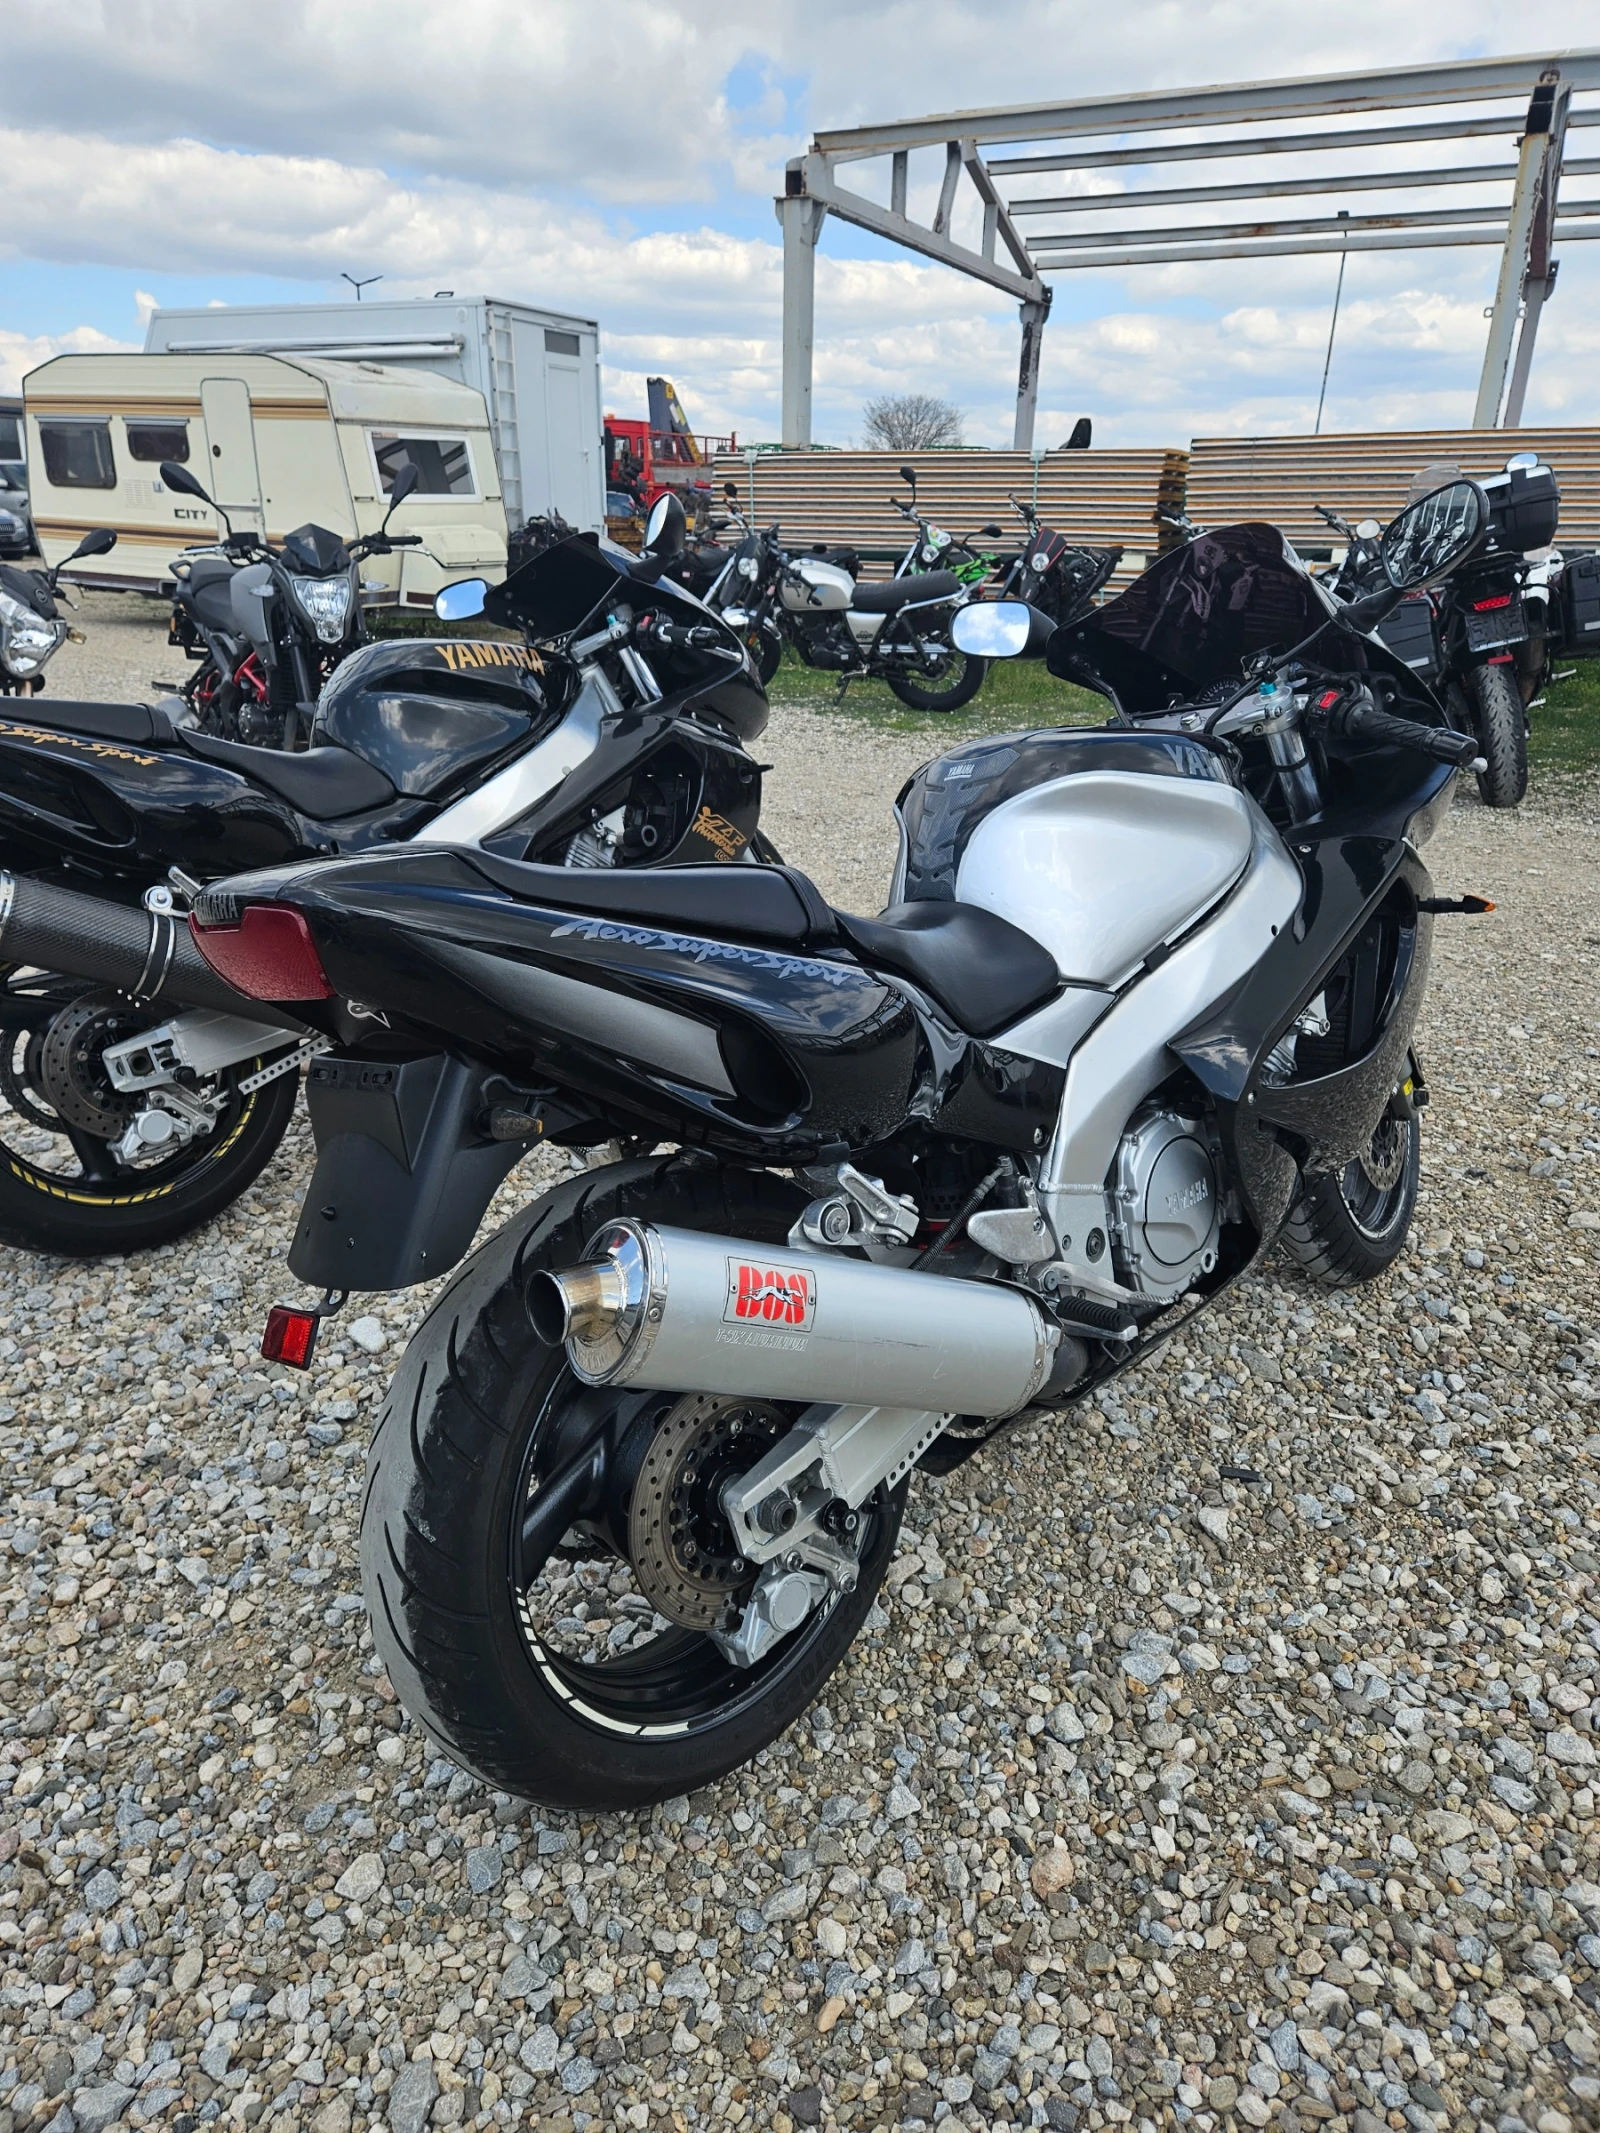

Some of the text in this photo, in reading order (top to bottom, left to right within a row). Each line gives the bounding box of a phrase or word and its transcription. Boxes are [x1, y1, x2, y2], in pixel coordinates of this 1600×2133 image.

[174, 508, 207, 520] CITY
[434, 643, 546, 676] YAMAHA
[550, 918, 851, 986] Aero Super Sport
[1165, 1177, 1209, 1217] YAMAHA
